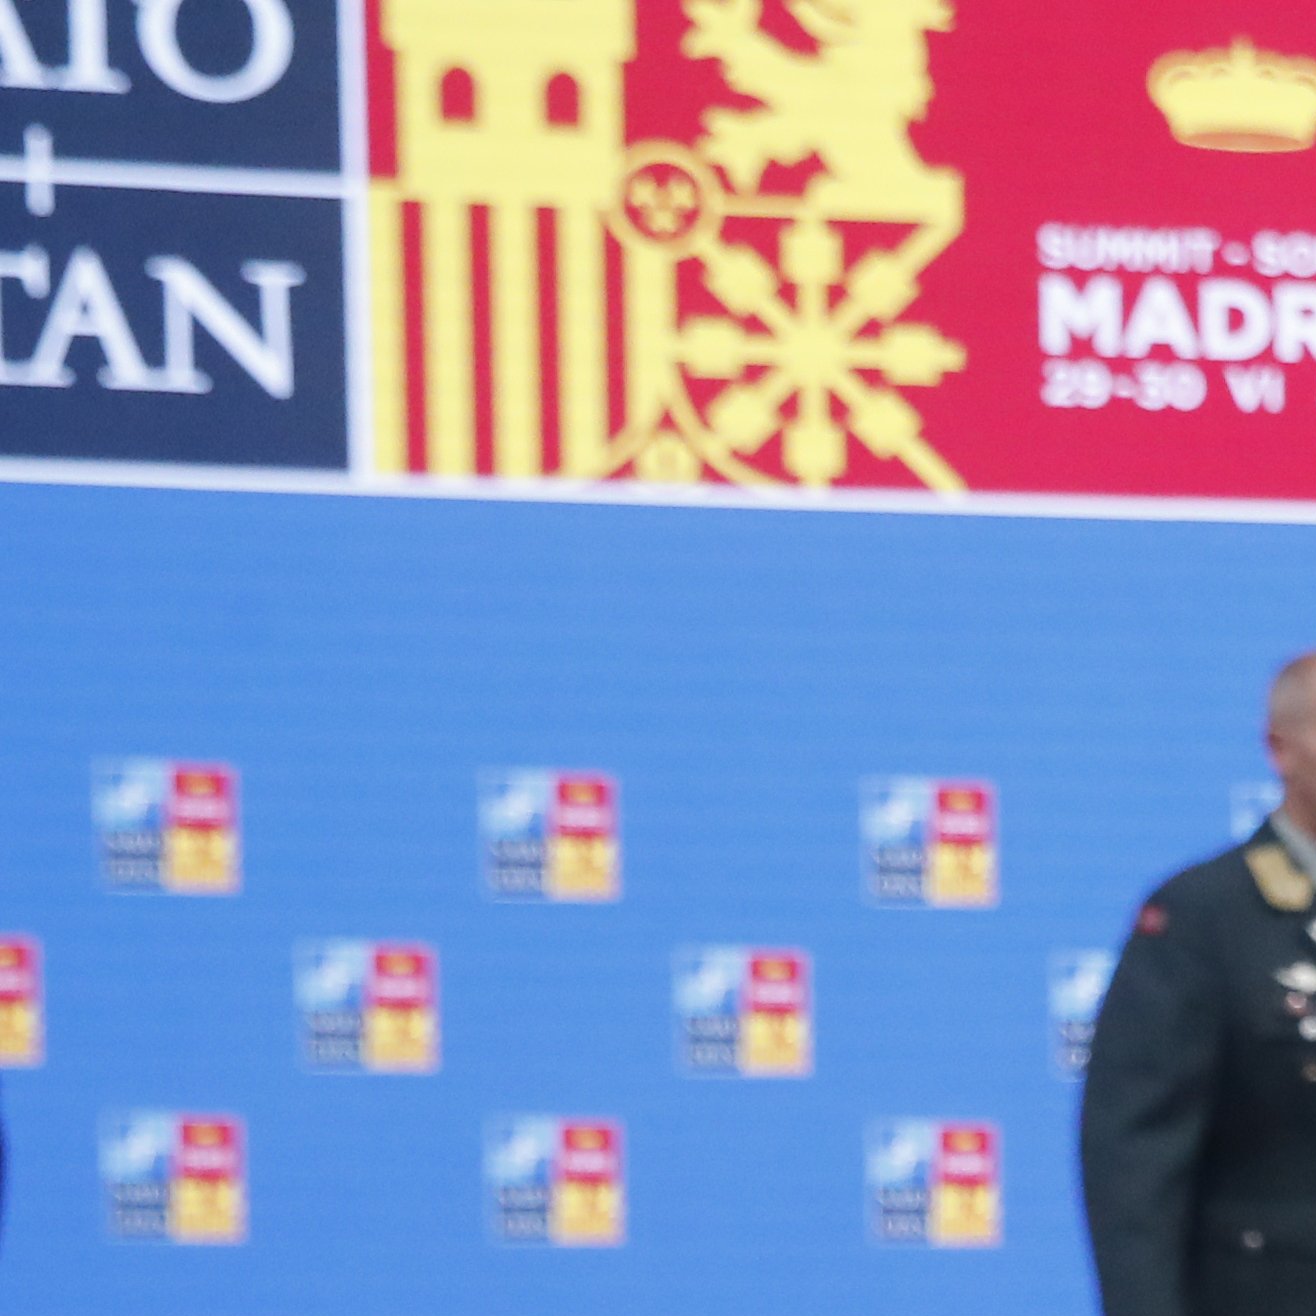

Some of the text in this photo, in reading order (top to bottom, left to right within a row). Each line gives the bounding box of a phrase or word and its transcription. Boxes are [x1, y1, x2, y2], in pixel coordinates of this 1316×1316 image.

[1036, 222, 1219, 274] SUMMIT
[1040, 357, 1207, 411] 29-30
[1223, 363, 1286, 413] VI
